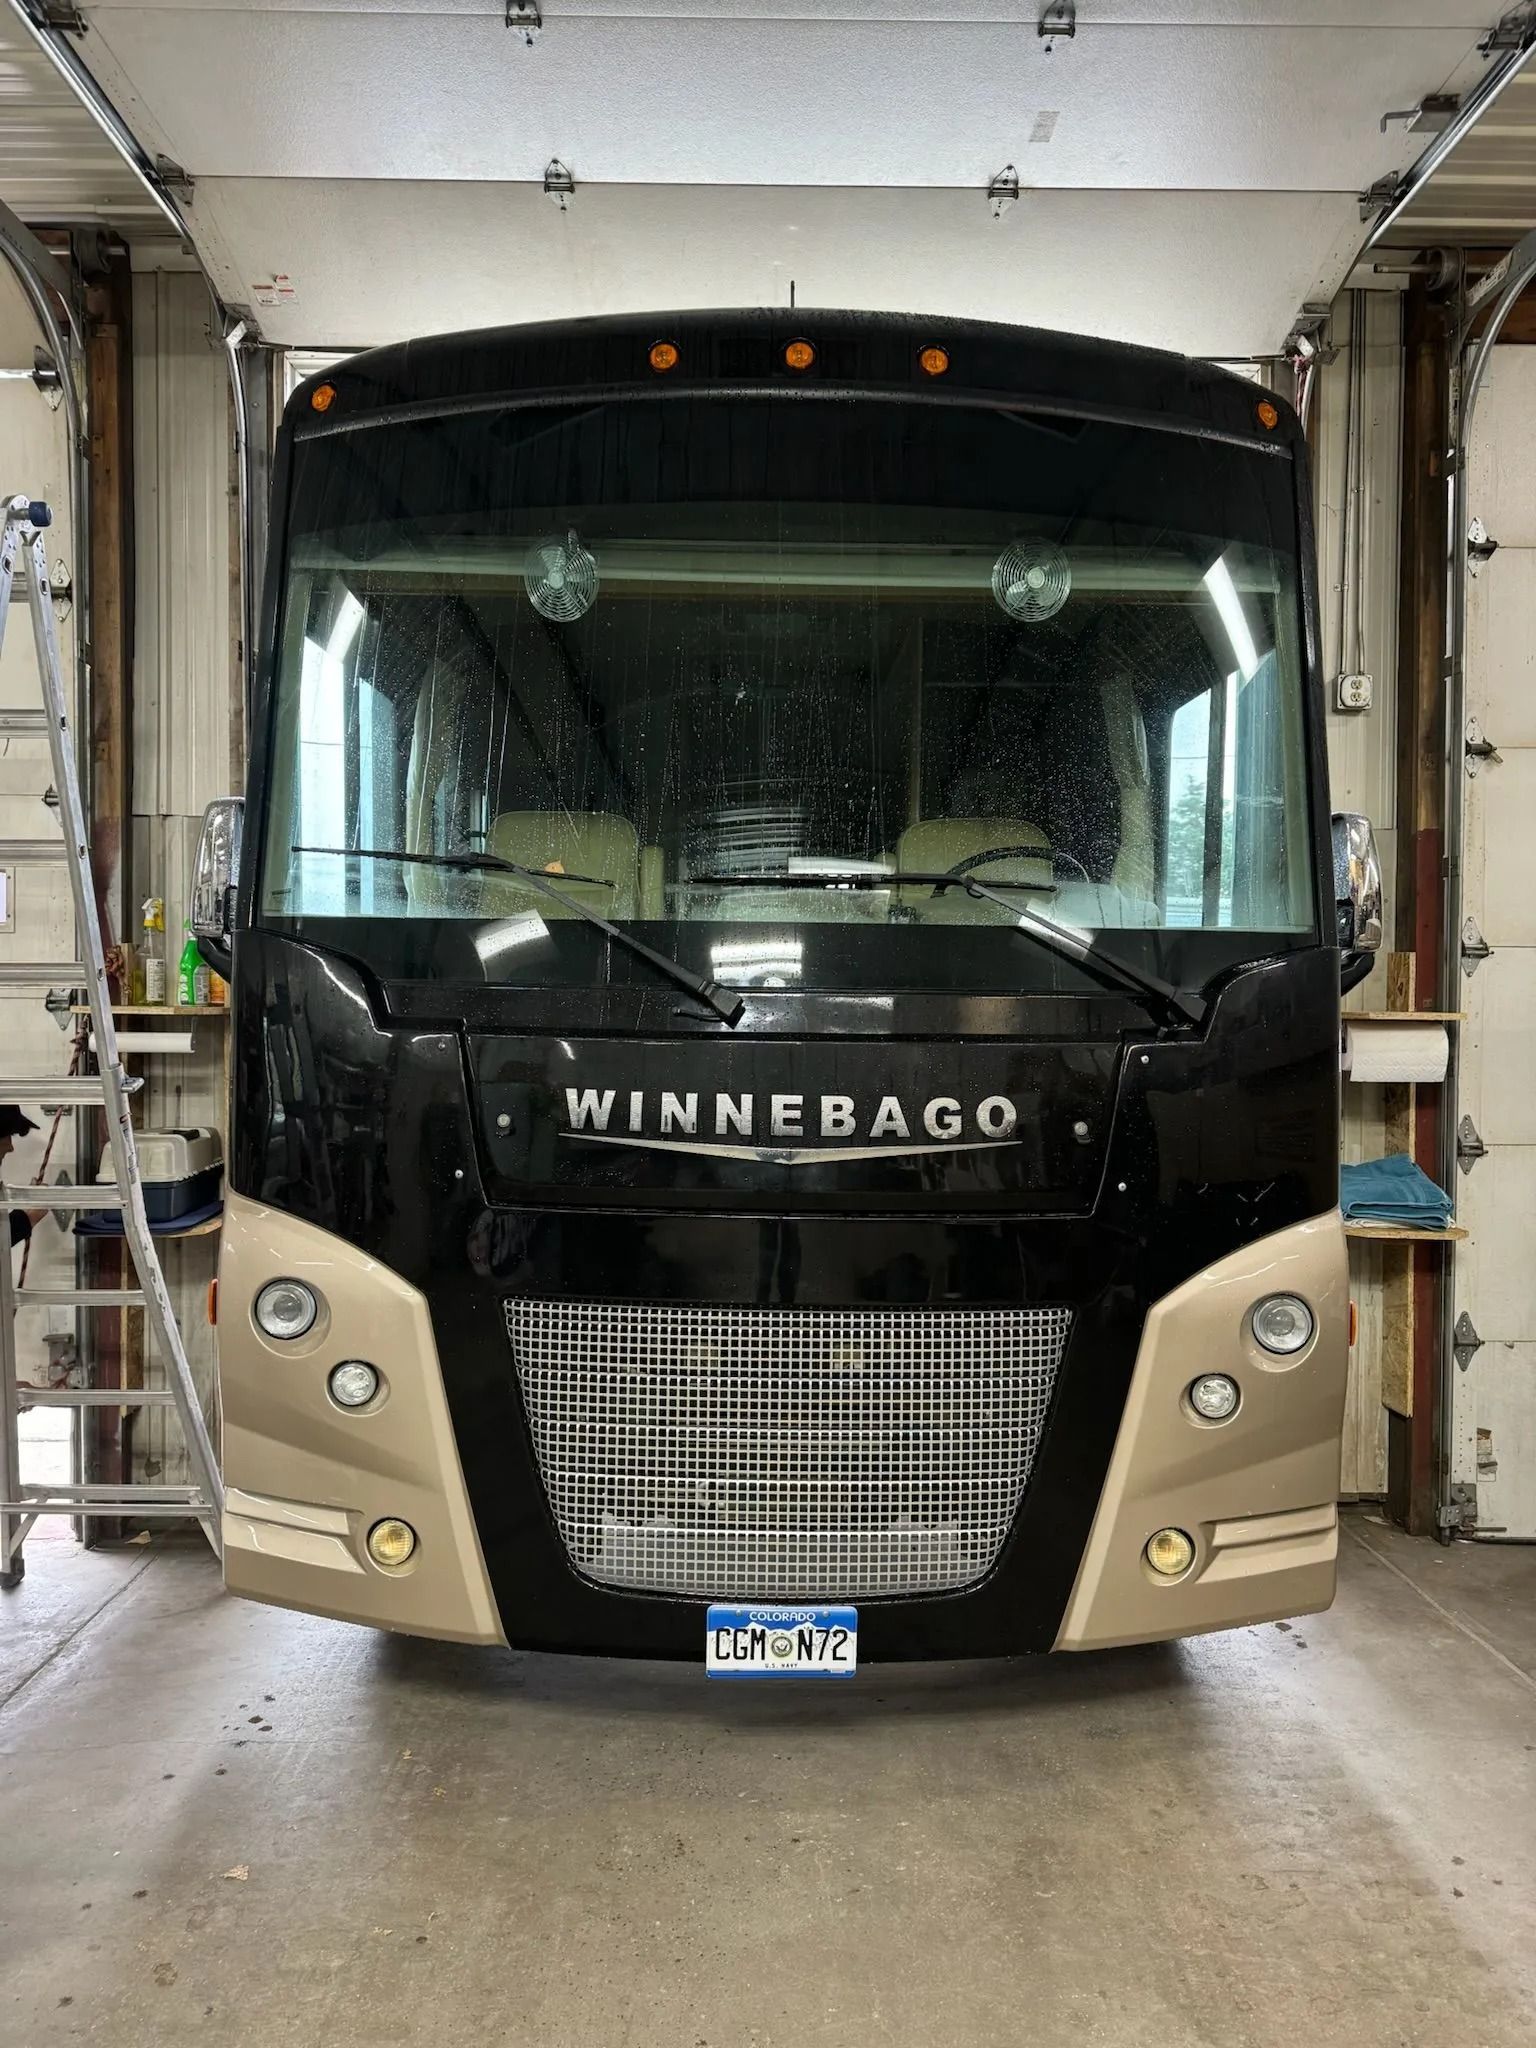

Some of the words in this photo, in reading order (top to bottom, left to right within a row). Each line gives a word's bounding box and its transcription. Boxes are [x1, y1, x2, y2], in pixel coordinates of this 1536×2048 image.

[565, 1088, 1018, 1139] WINNEBAGO
[749, 1611, 816, 1622] COLORADO
[715, 1628, 766, 1661] CGM
[797, 1628, 848, 1661] N72
